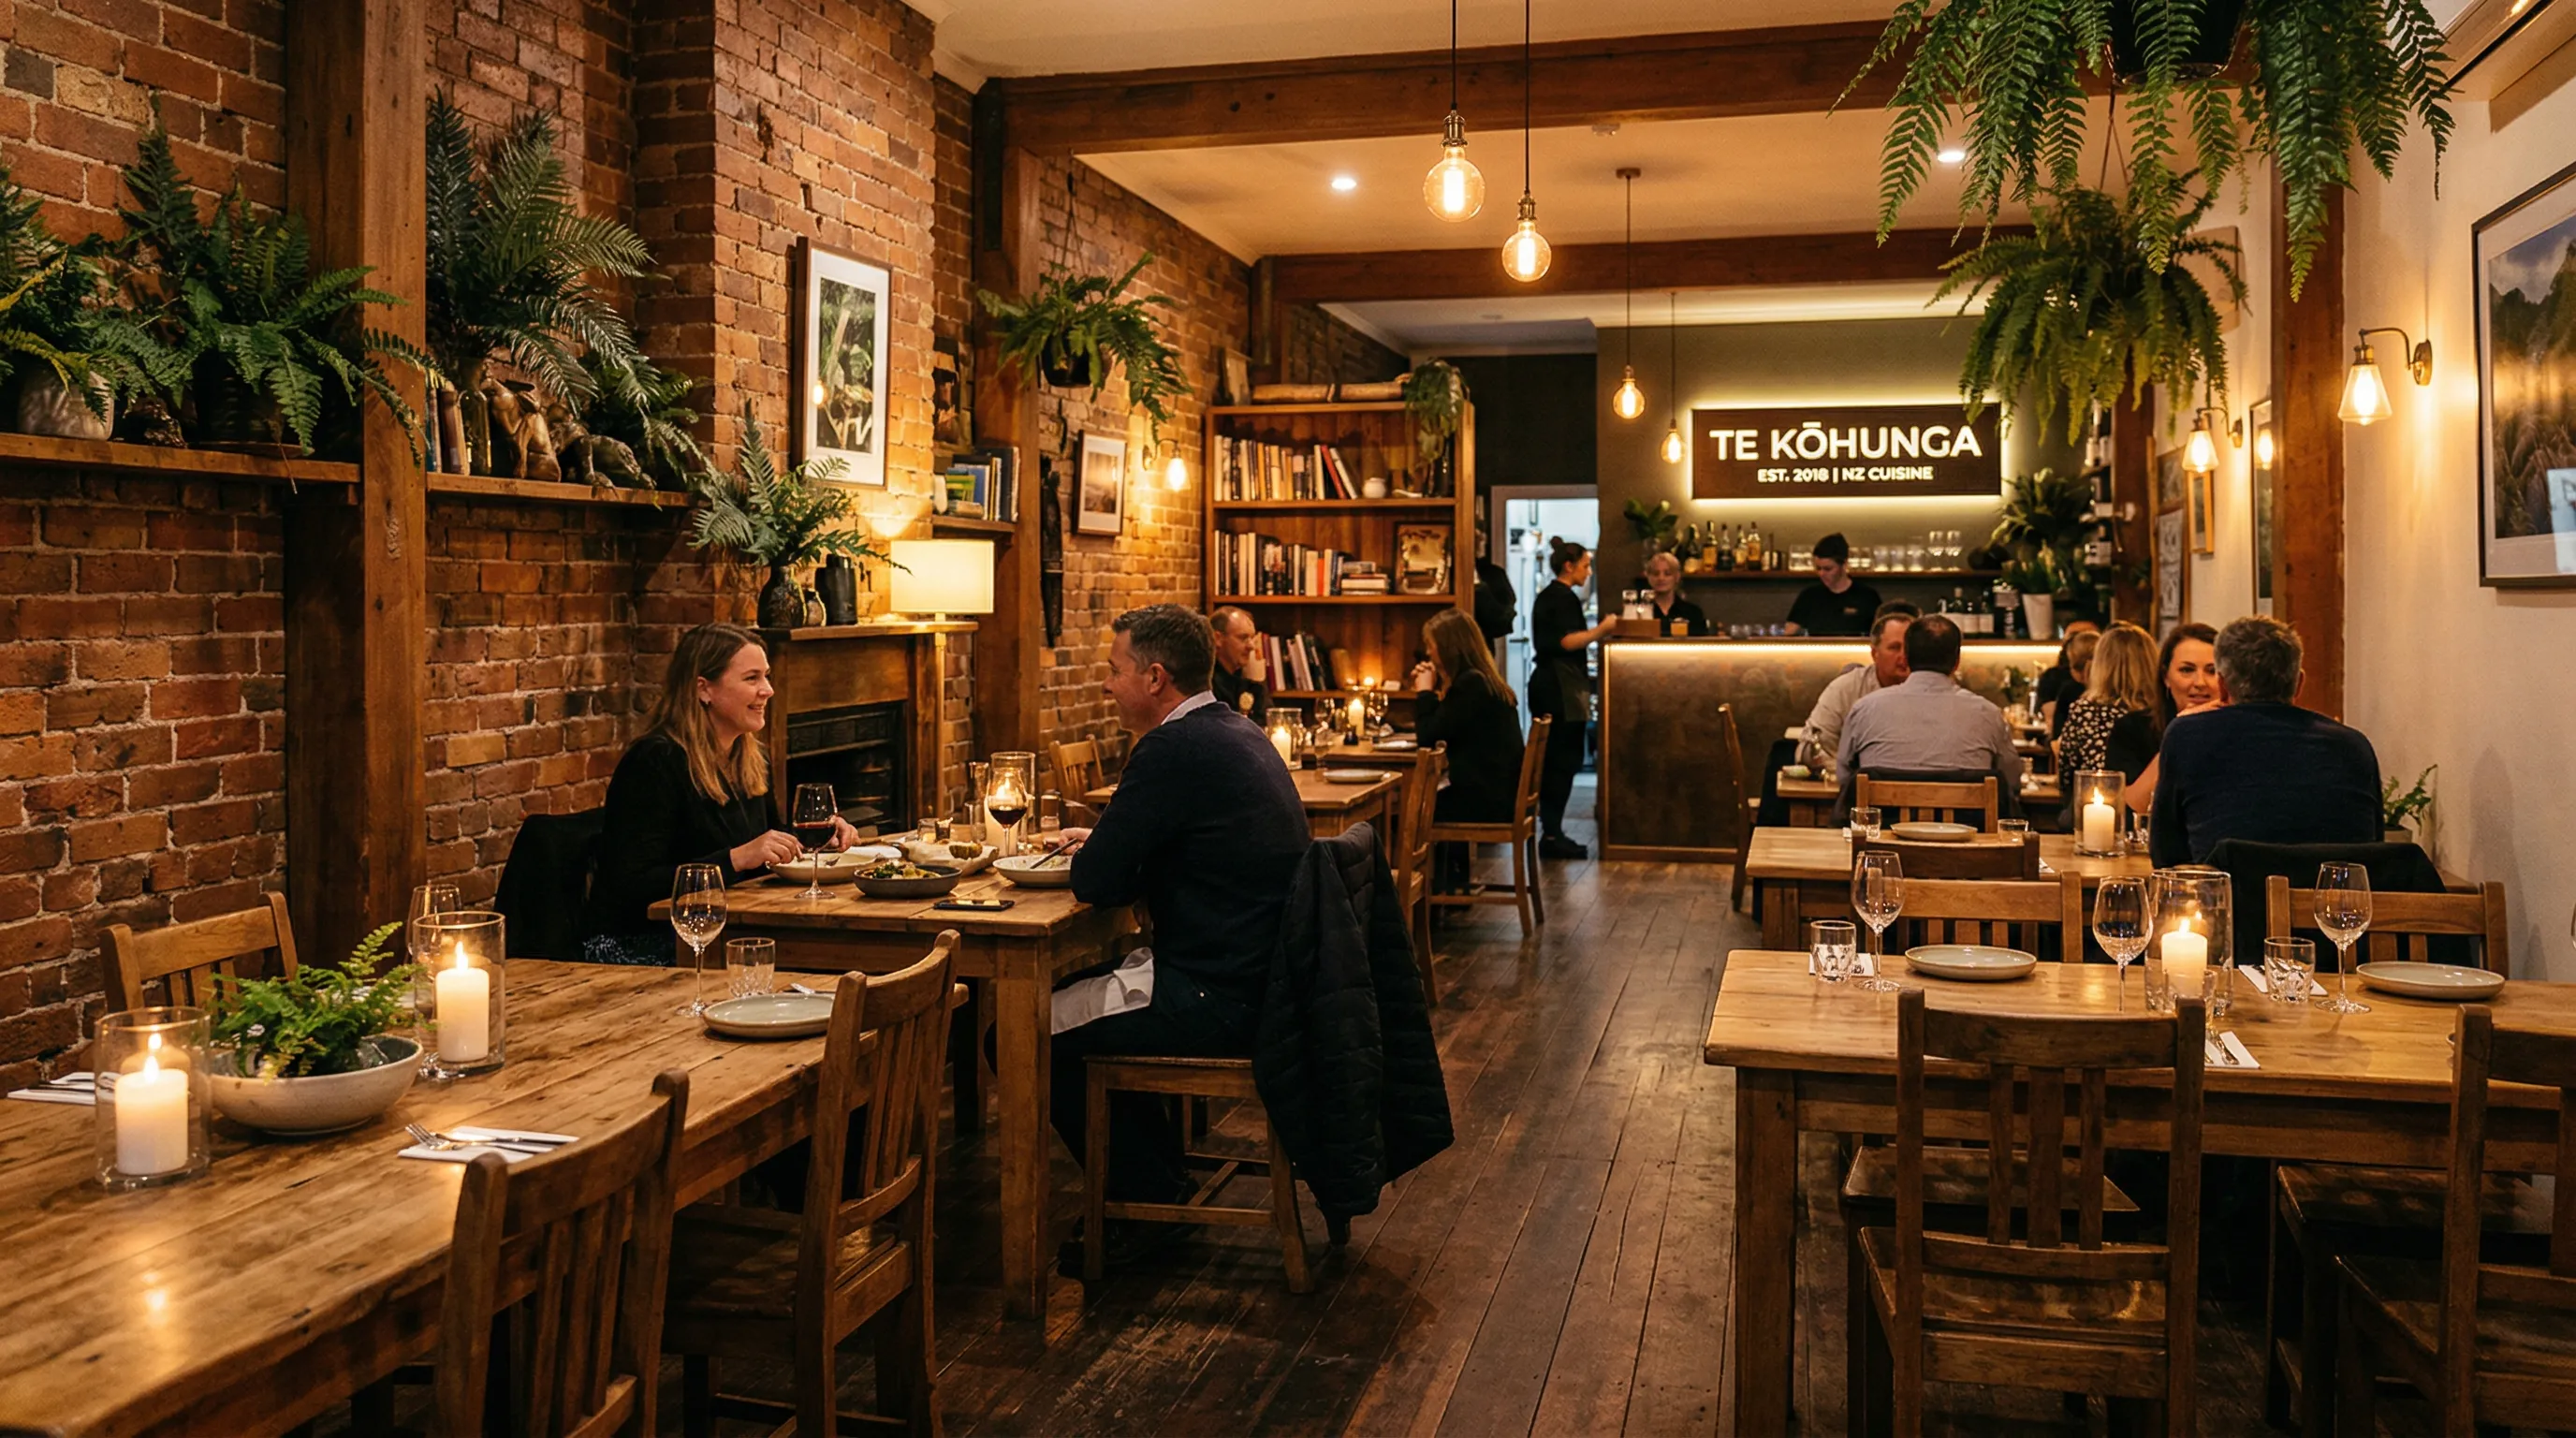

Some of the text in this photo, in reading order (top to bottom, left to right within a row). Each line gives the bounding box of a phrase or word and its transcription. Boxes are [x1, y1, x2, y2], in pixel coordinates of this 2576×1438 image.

[1708, 421, 1983, 461] TE KŌHUNGA
[1757, 468, 1790, 483] EST.
[1842, 467, 1866, 481] NZ
[1867, 466, 1934, 481] CUISINE
